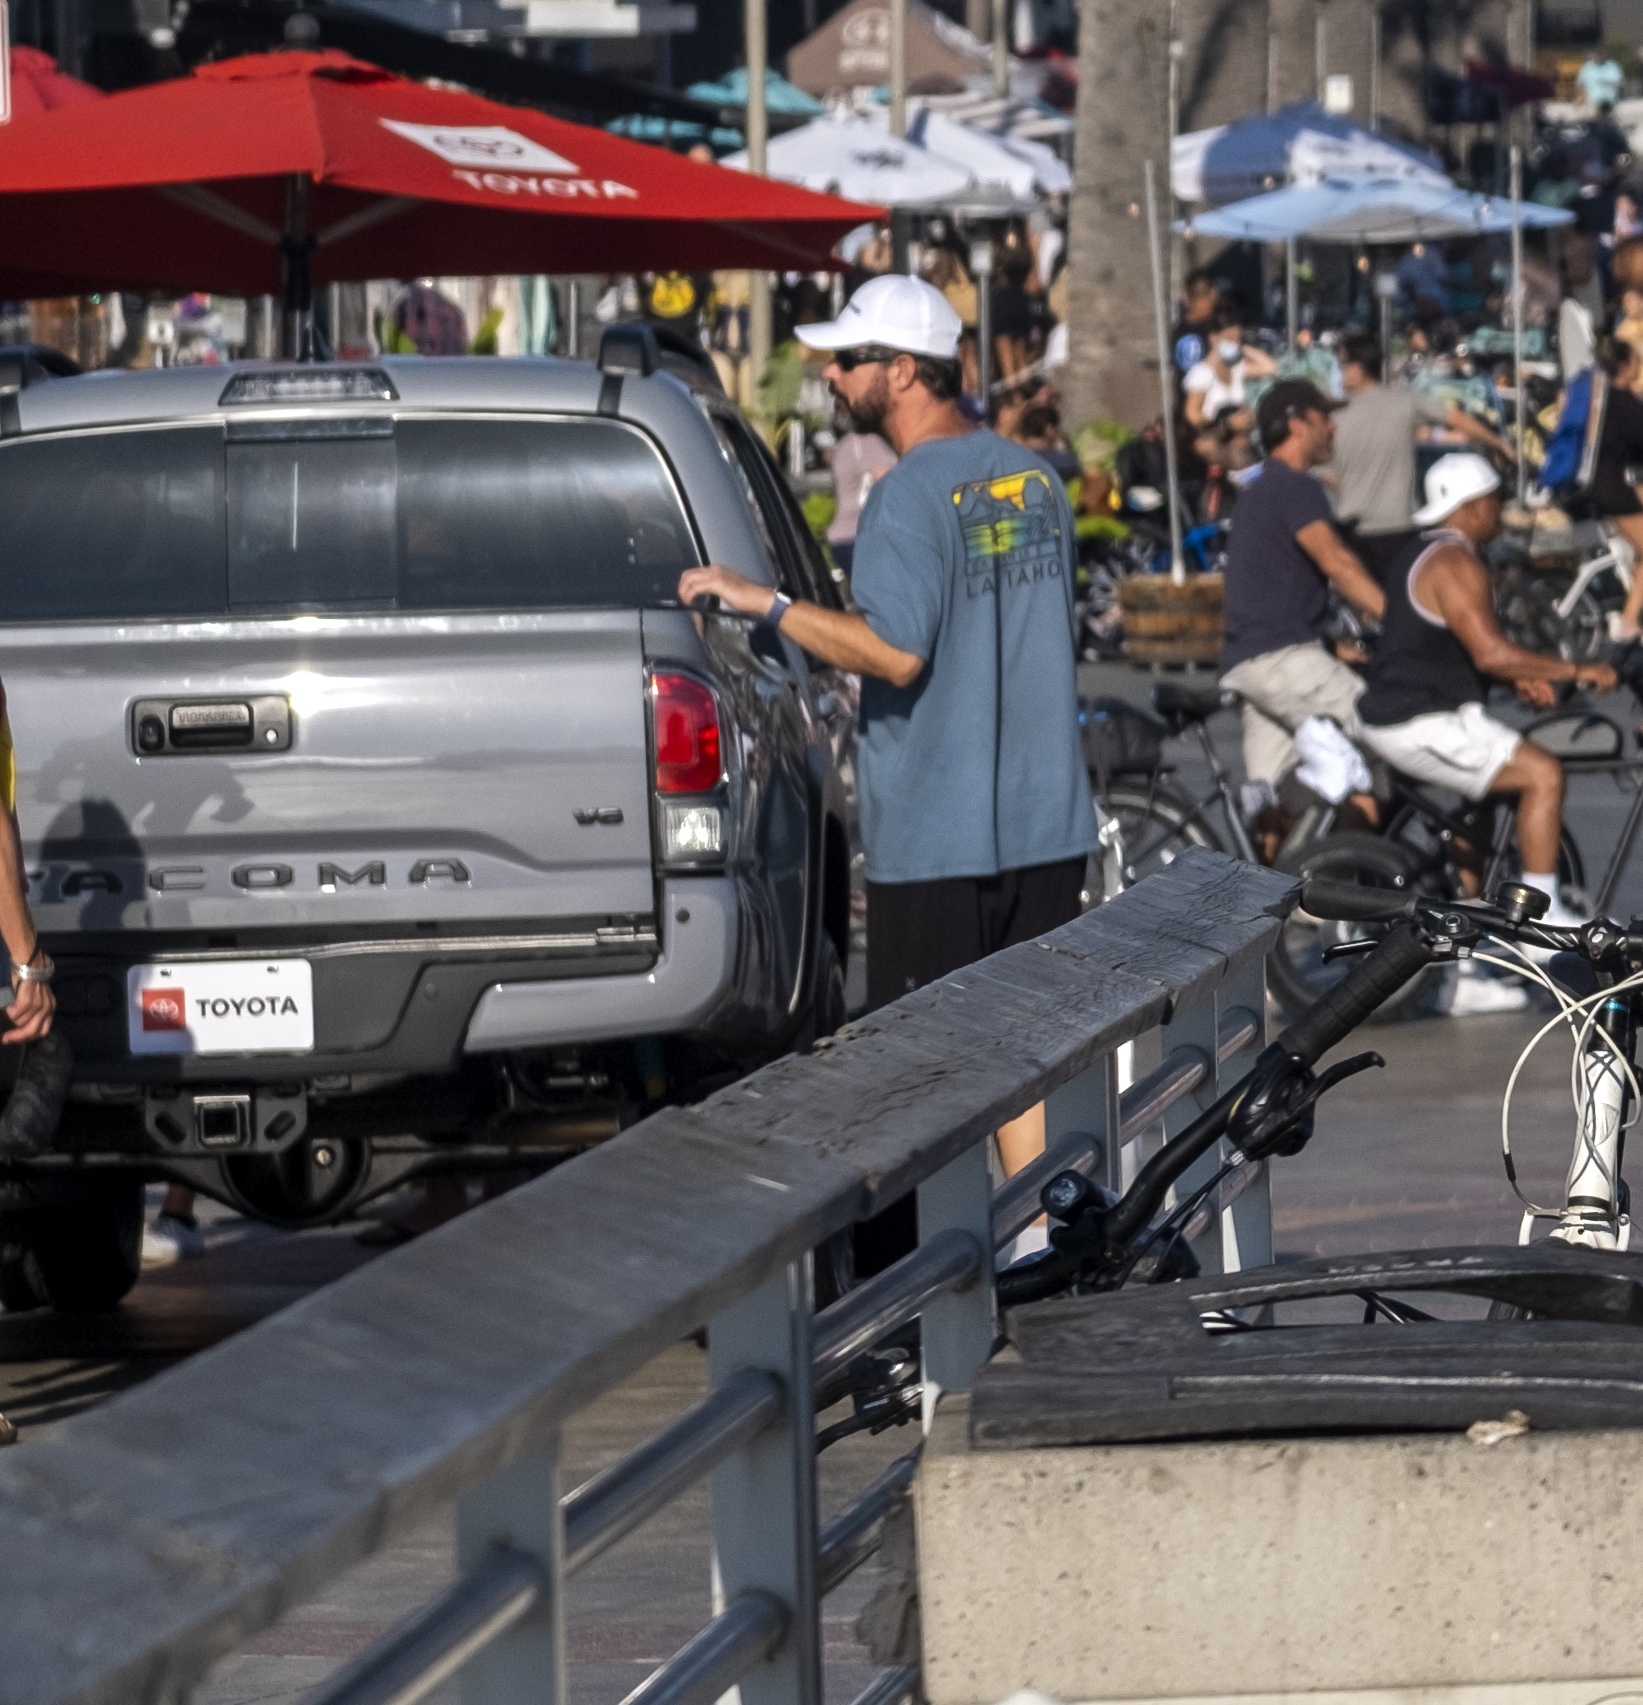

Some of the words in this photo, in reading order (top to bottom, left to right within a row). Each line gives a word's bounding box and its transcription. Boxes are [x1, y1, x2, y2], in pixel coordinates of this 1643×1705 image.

[452, 168, 639, 199] TOYOTA
[26, 857, 471, 894] ACOMA
[195, 995, 299, 1018] TOYOTA
